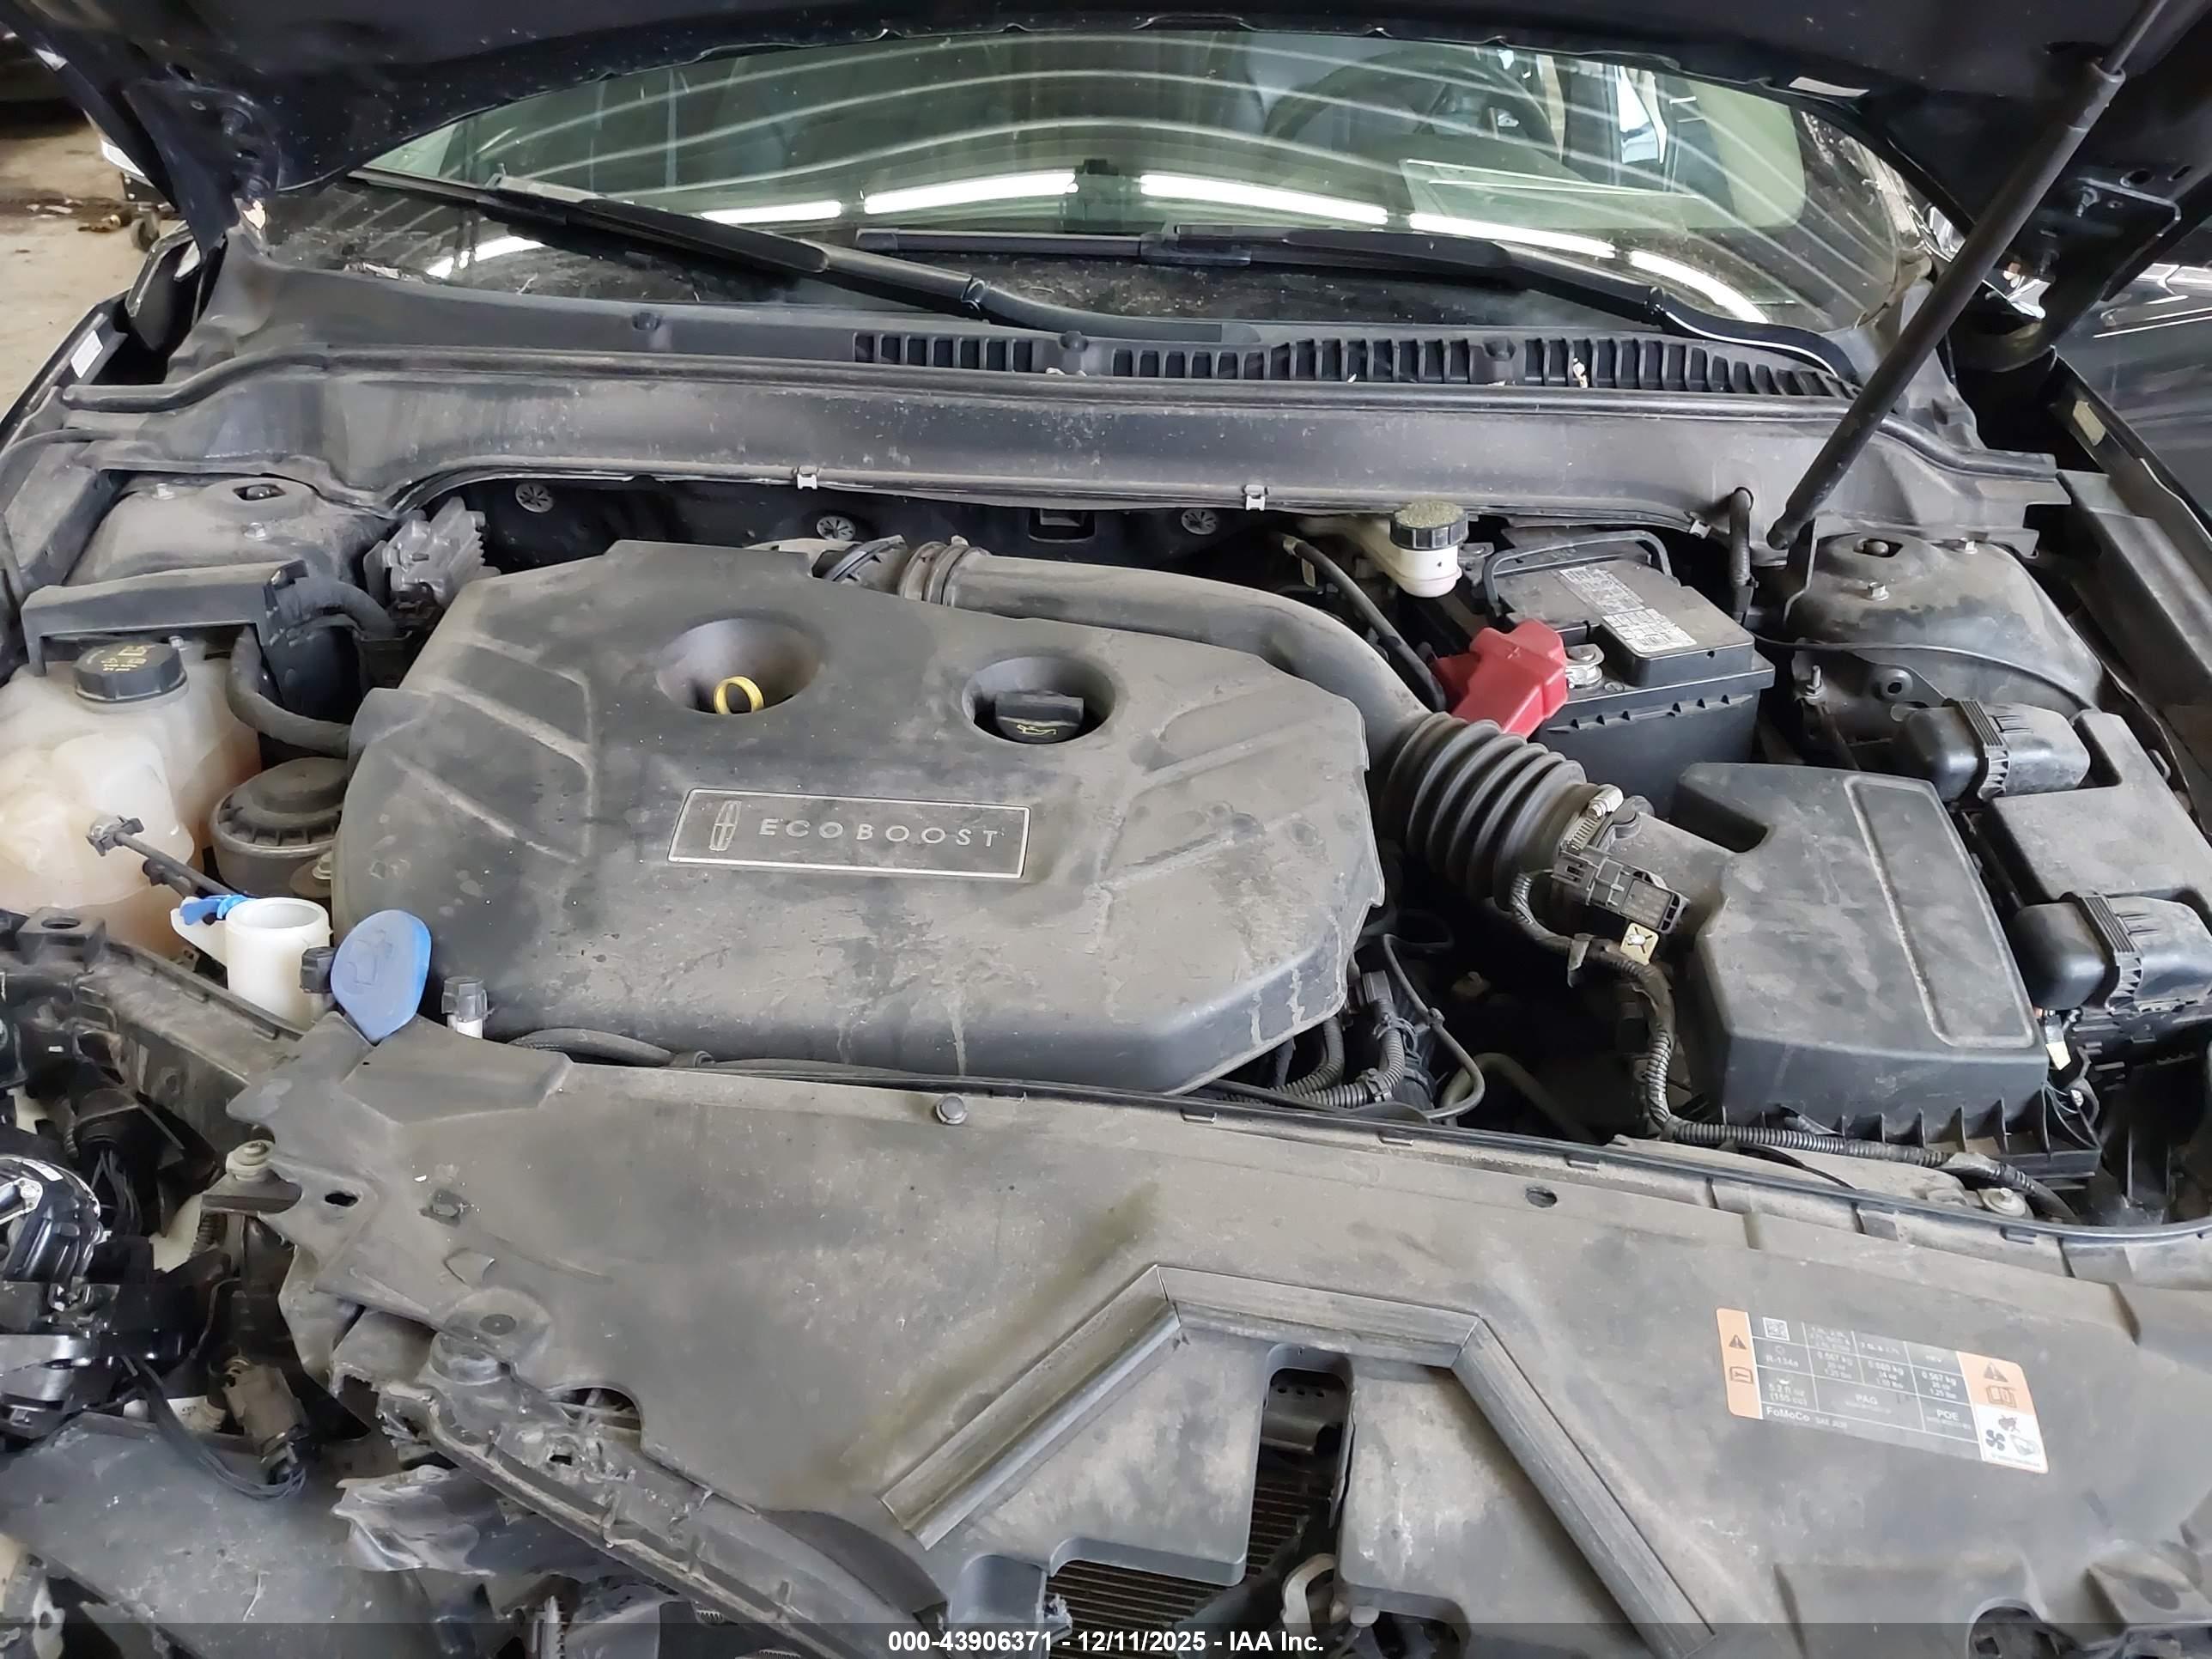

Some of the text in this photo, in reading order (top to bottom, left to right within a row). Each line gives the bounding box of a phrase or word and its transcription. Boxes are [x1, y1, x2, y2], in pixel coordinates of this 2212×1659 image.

[758, 817, 999, 848] ECOBOOST
[1945, 1376, 1957, 1387] kg
[1855, 1394, 1879, 1405] PAG
[1766, 1407, 1811, 1422] FoMoCo
[1936, 1409, 1959, 1421] POE
